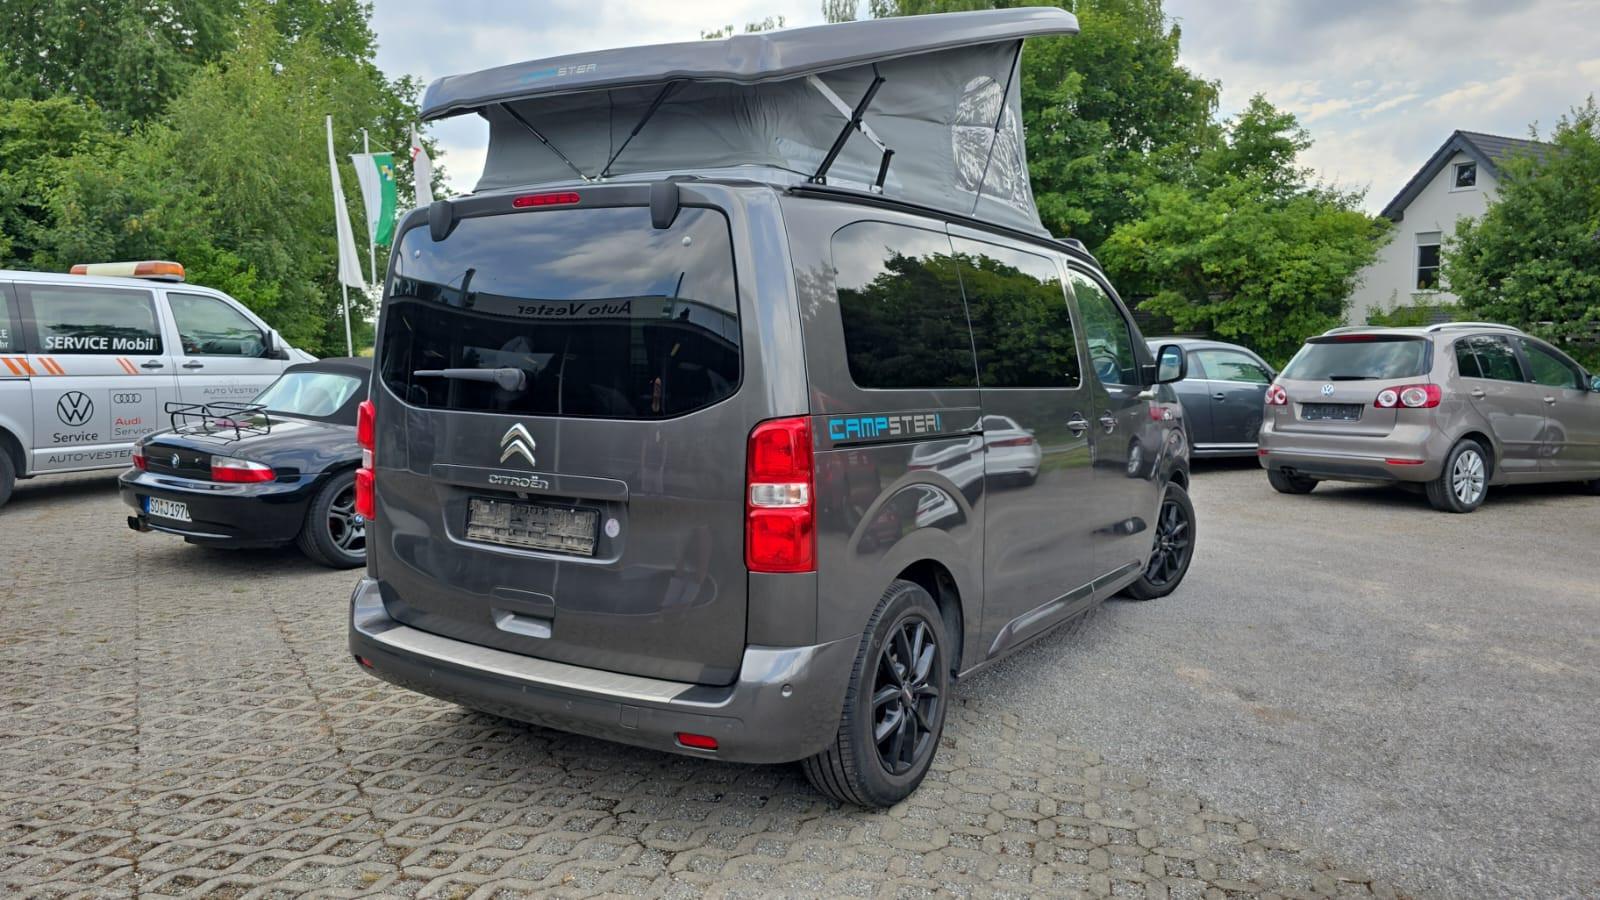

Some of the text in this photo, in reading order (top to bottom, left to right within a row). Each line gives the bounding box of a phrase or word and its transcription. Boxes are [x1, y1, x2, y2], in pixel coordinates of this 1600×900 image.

[45, 336, 154, 351] SERVICE Mobil
[114, 416, 142, 426] Audi
[829, 414, 942, 440] CAMPSTER
[52, 431, 99, 443] Service
[114, 427, 154, 436] Service
